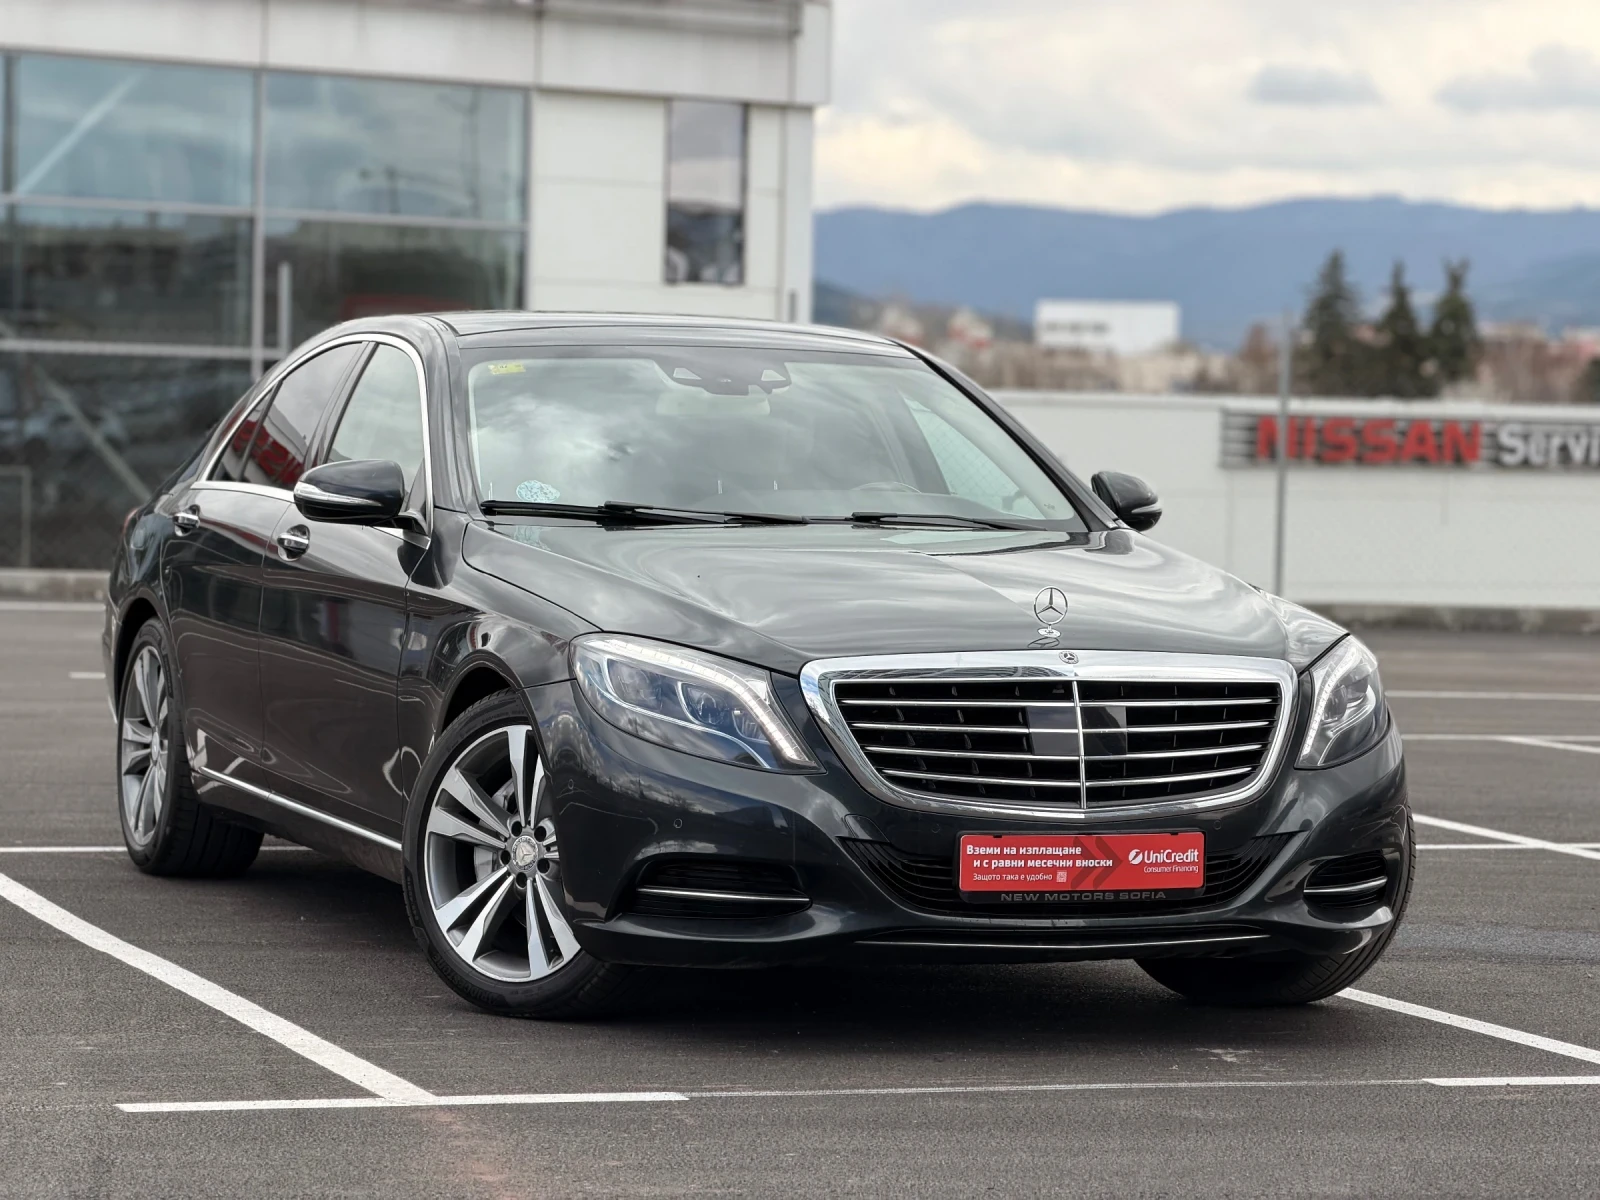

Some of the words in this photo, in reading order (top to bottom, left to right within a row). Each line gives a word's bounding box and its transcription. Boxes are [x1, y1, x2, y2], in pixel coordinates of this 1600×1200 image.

[1256, 414, 1482, 464] NISSAN
[966, 844, 1001, 855] Вземи
[1003, 846, 1017, 855] на
[1019, 846, 1082, 857] изплащане
[1144, 849, 1199, 863] UniCredit
[991, 860, 1025, 870] равни
[1027, 859, 1073, 867] месечни
[1075, 859, 1113, 867] вноски
[1172, 865, 1199, 873] Financing
[973, 873, 1001, 881] Защото
[1026, 873, 1053, 881] удобно
[1000, 893, 1040, 901] NEW
[1044, 892, 1115, 901] MOTORS
[1119, 891, 1166, 900] SOFIA
